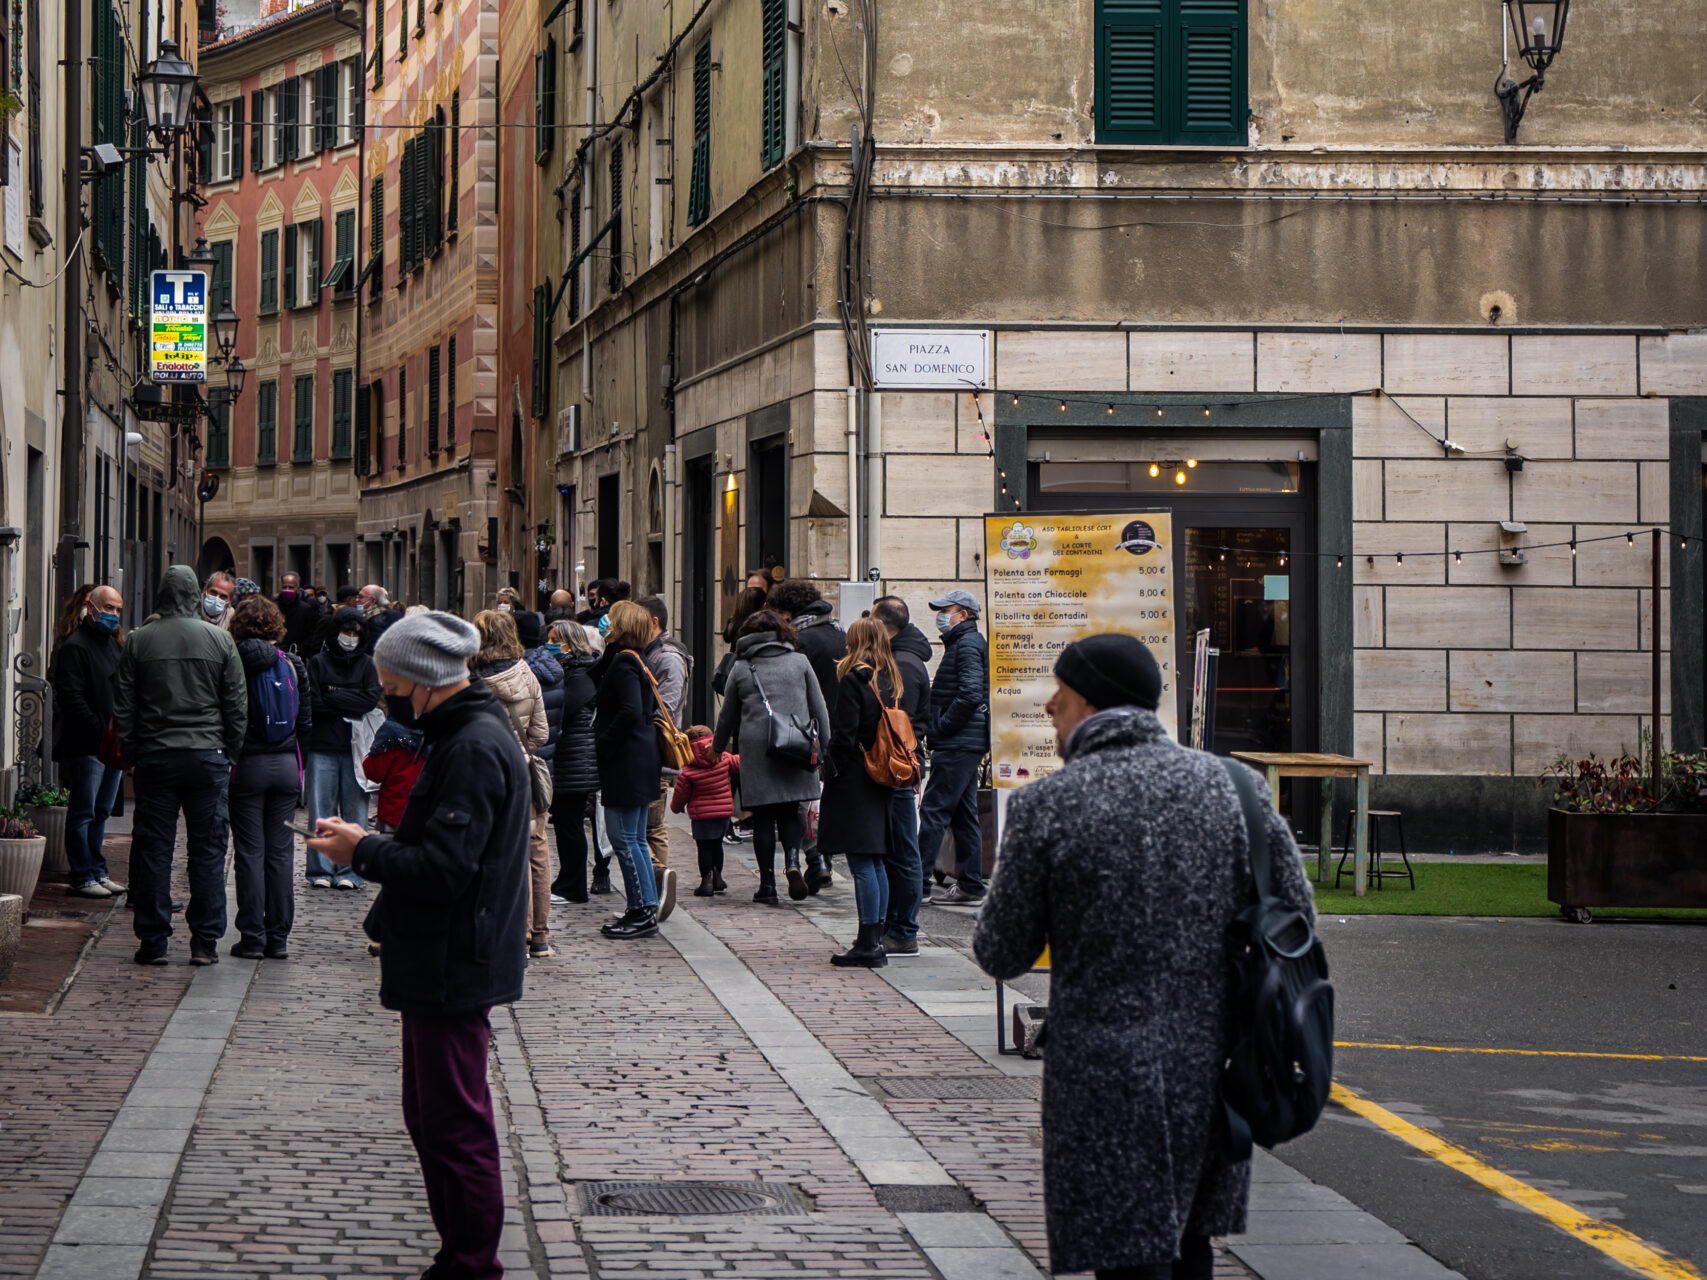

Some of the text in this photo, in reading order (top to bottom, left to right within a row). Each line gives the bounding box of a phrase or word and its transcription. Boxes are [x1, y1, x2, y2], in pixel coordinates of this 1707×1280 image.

[166, 274, 193, 304] T
[909, 345, 950, 354] PIAZZA
[157, 362, 194, 370] Enalotto
[885, 364, 975, 374] SAN DOMENICO
[994, 569, 1025, 577] Polenta
[1044, 568, 1083, 578] Formaggi
[1139, 566, 1158, 576] 5,00
[1160, 566, 1166, 574] €
[994, 591, 1025, 599] Polenta
[1045, 590, 1087, 598] Chiocciole
[1139, 589, 1158, 598] 8,00
[995, 612, 1031, 620] Ribollita
[1033, 612, 1046, 620] dei
[1048, 612, 1088, 620] Contadini
[1140, 611, 1159, 620] 5,00
[995, 632, 1168, 645] Formaggi 5,00 €
[1013, 642, 1036, 650] Miele
[996, 665, 1049, 674] Chiarestrelli
[1162, 662, 1169, 670] €
[997, 683, 1169, 696] Acqua €
